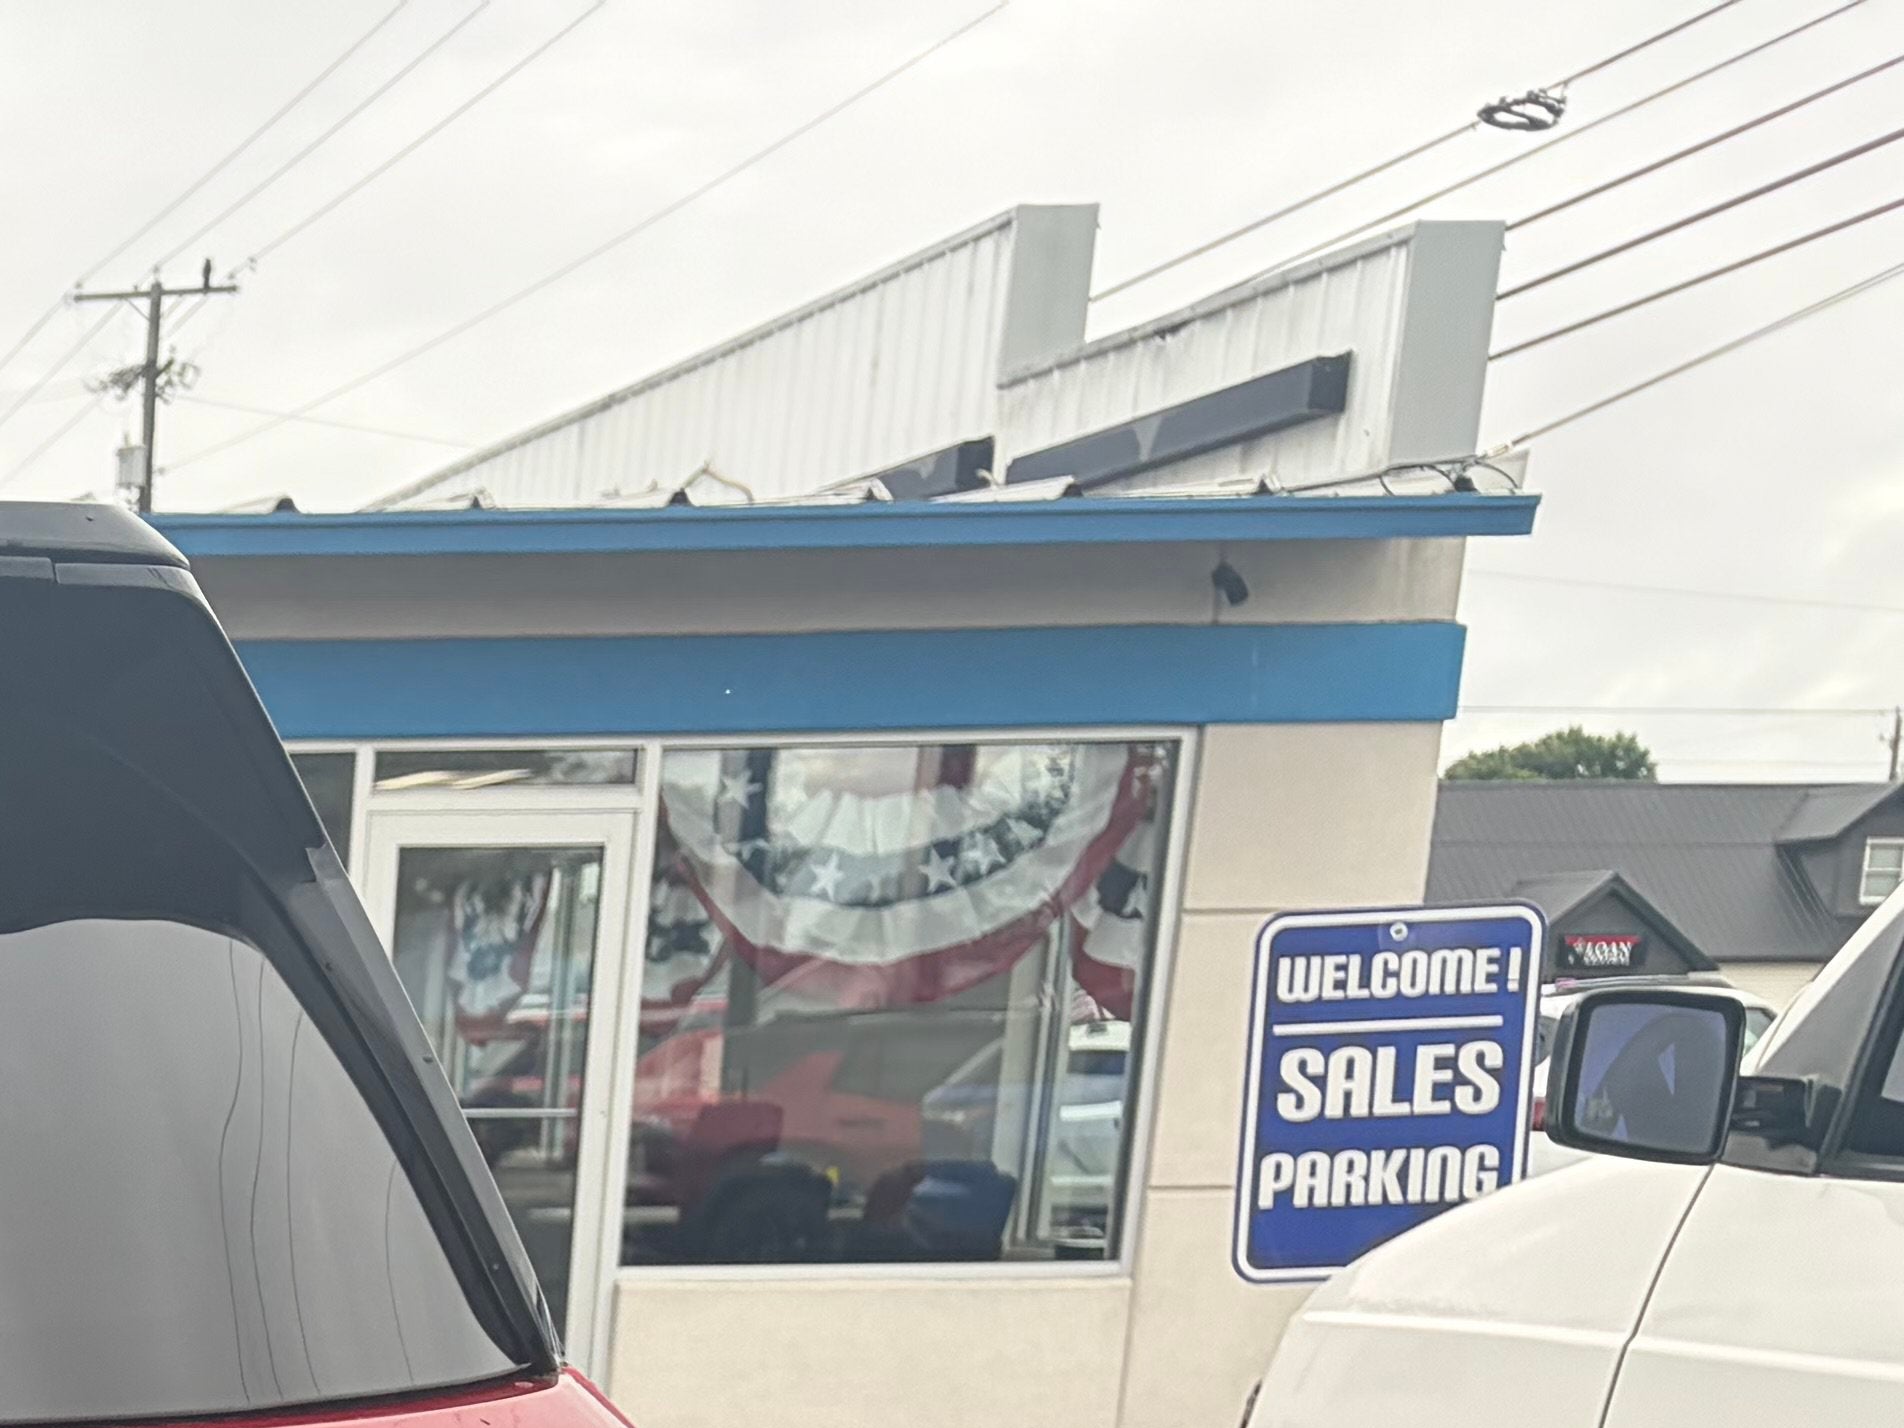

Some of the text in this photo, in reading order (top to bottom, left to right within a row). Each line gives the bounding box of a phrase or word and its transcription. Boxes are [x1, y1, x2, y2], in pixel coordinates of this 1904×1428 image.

[1277, 947, 1523, 1002] WELCOME!
[1276, 1040, 1504, 1122] SALES
[1258, 1144, 1501, 1210] PARKING
